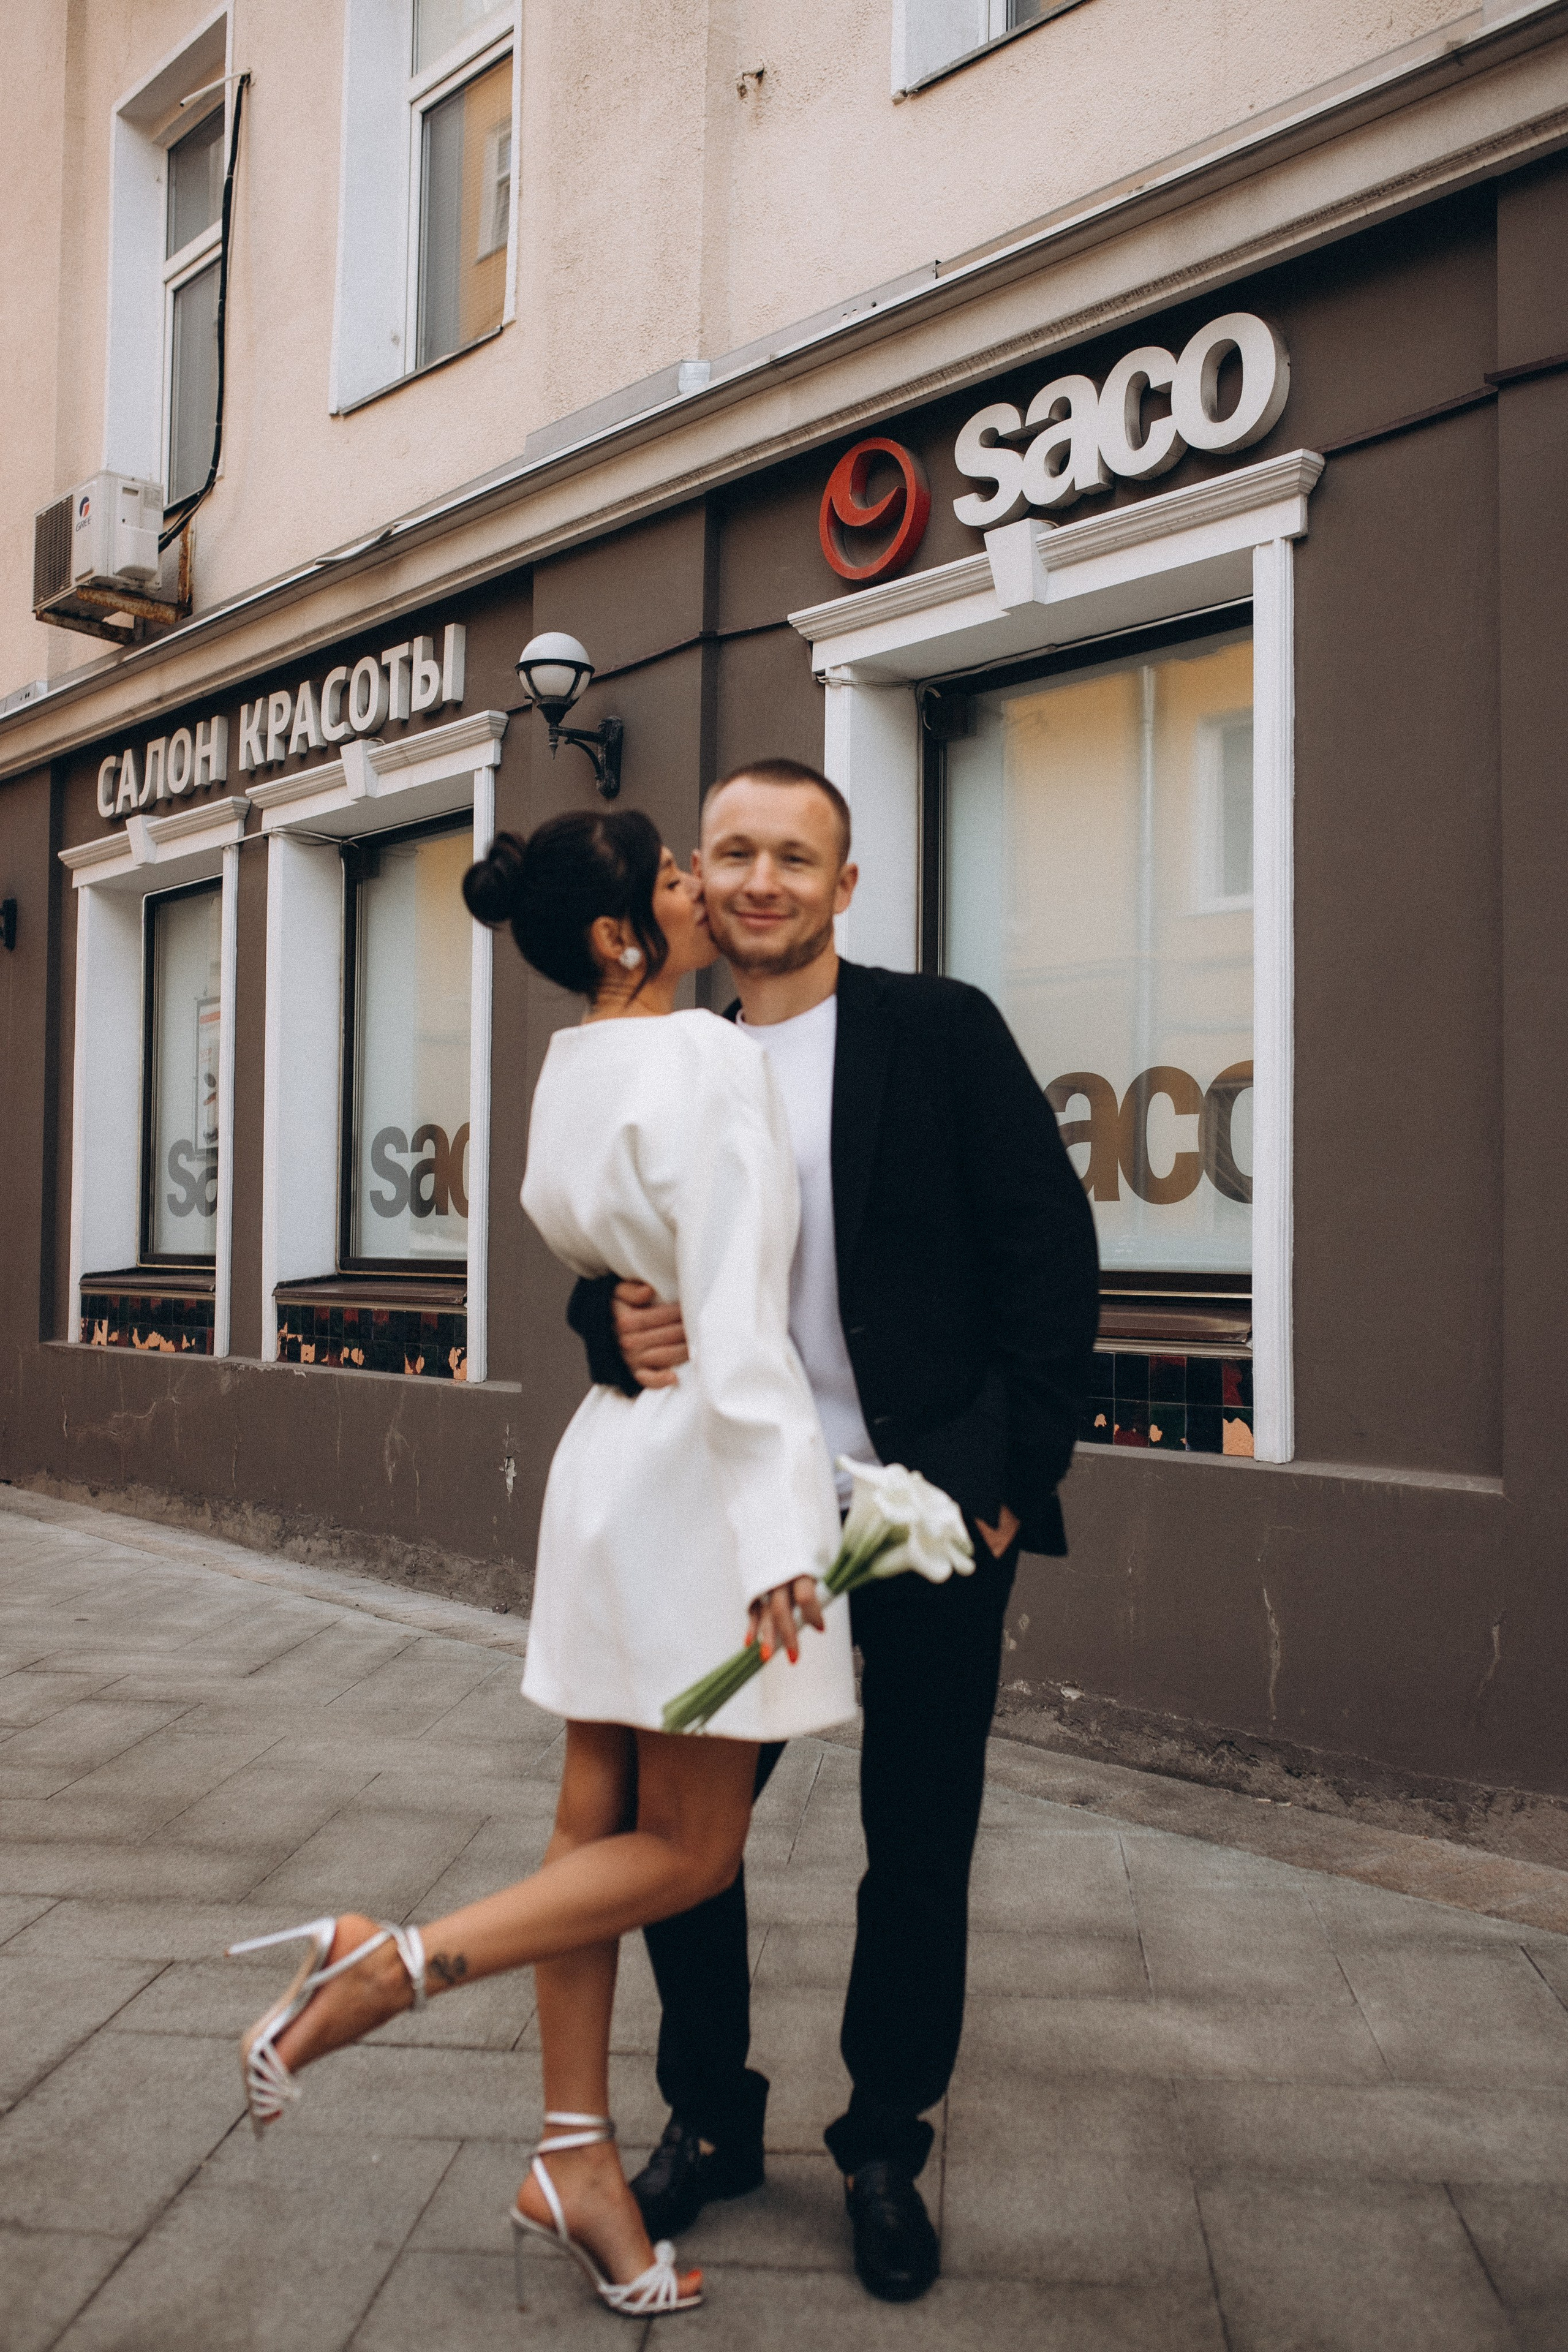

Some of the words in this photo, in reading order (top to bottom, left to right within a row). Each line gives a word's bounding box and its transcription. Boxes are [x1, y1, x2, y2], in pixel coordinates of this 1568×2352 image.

[953, 312, 1290, 528] saco
[75, 515, 92, 532] GREE
[97, 715, 228, 818] САЛОН
[239, 623, 466, 772] КРАСОТЫ
